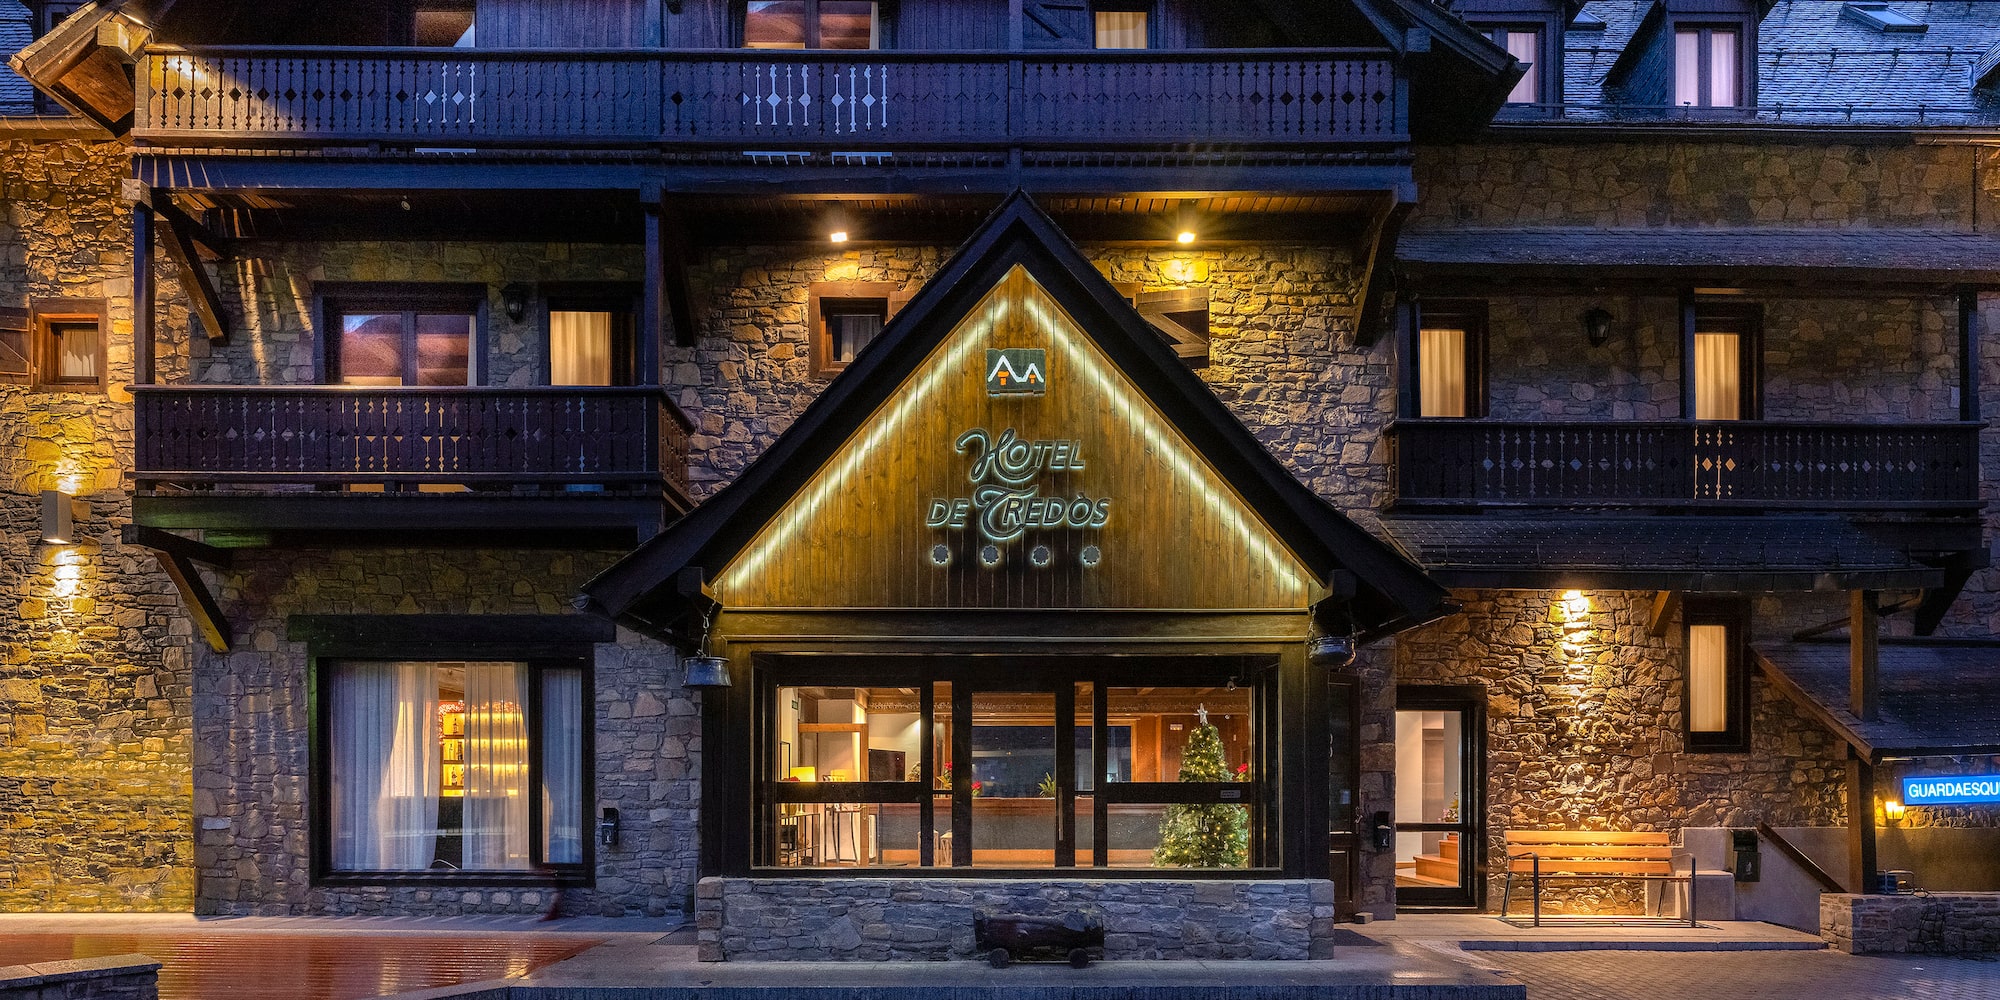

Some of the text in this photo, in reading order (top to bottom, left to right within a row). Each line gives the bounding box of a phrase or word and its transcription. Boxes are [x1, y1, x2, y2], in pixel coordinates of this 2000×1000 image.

[955, 428, 1085, 482] HOTEL
[926, 484, 1112, 540] DE TREDÒS
[1908, 781, 2000, 798] GUARDAESQU
